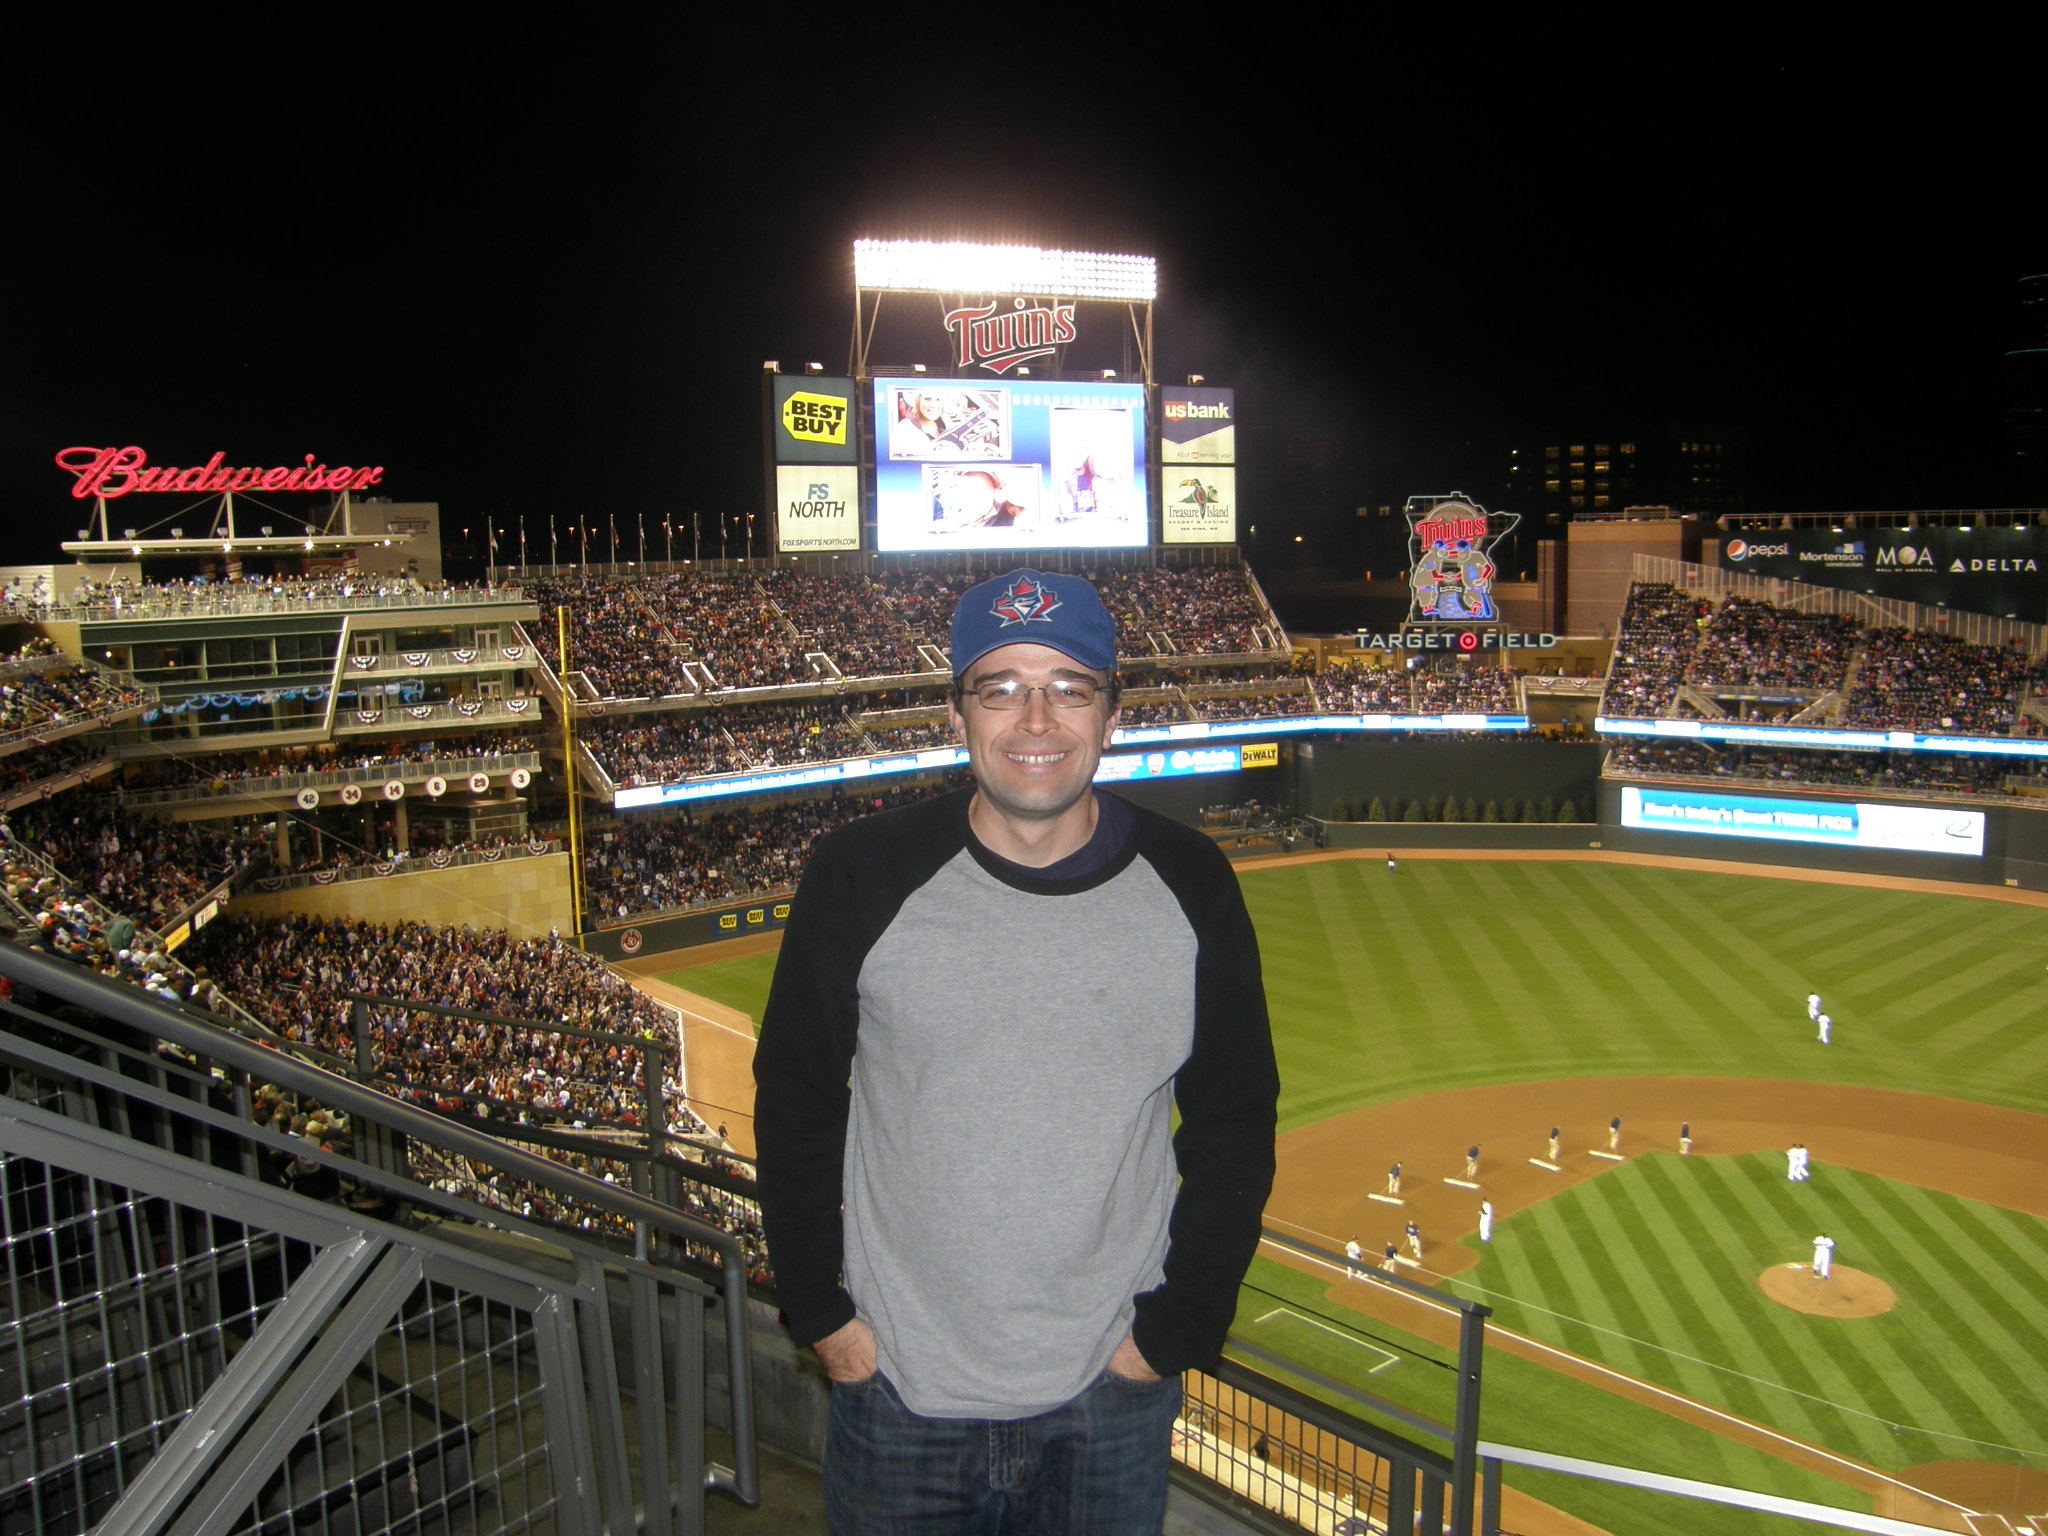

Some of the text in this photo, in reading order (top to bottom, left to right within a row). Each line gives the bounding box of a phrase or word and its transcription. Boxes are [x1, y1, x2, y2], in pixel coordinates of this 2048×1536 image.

[944, 298, 1076, 367] Twins
[791, 400, 845, 421] BEST
[1165, 402, 1231, 419] usbank
[793, 417, 841, 436] BUY
[55, 446, 384, 498] Budweiser
[807, 483, 829, 500] FS
[789, 501, 845, 518] NORTH
[1168, 505, 1229, 518] Treasure Island
[1415, 515, 1486, 550] Twins
[1748, 543, 1788, 557] pepsi
[1800, 552, 1864, 562] Mortenson
[1972, 559, 2037, 571] DELTA
[1357, 633, 1557, 648] TARGET FIELD
[518, 774, 525, 783] 3
[389, 785, 400, 796] 14
[302, 794, 315, 804] 42
